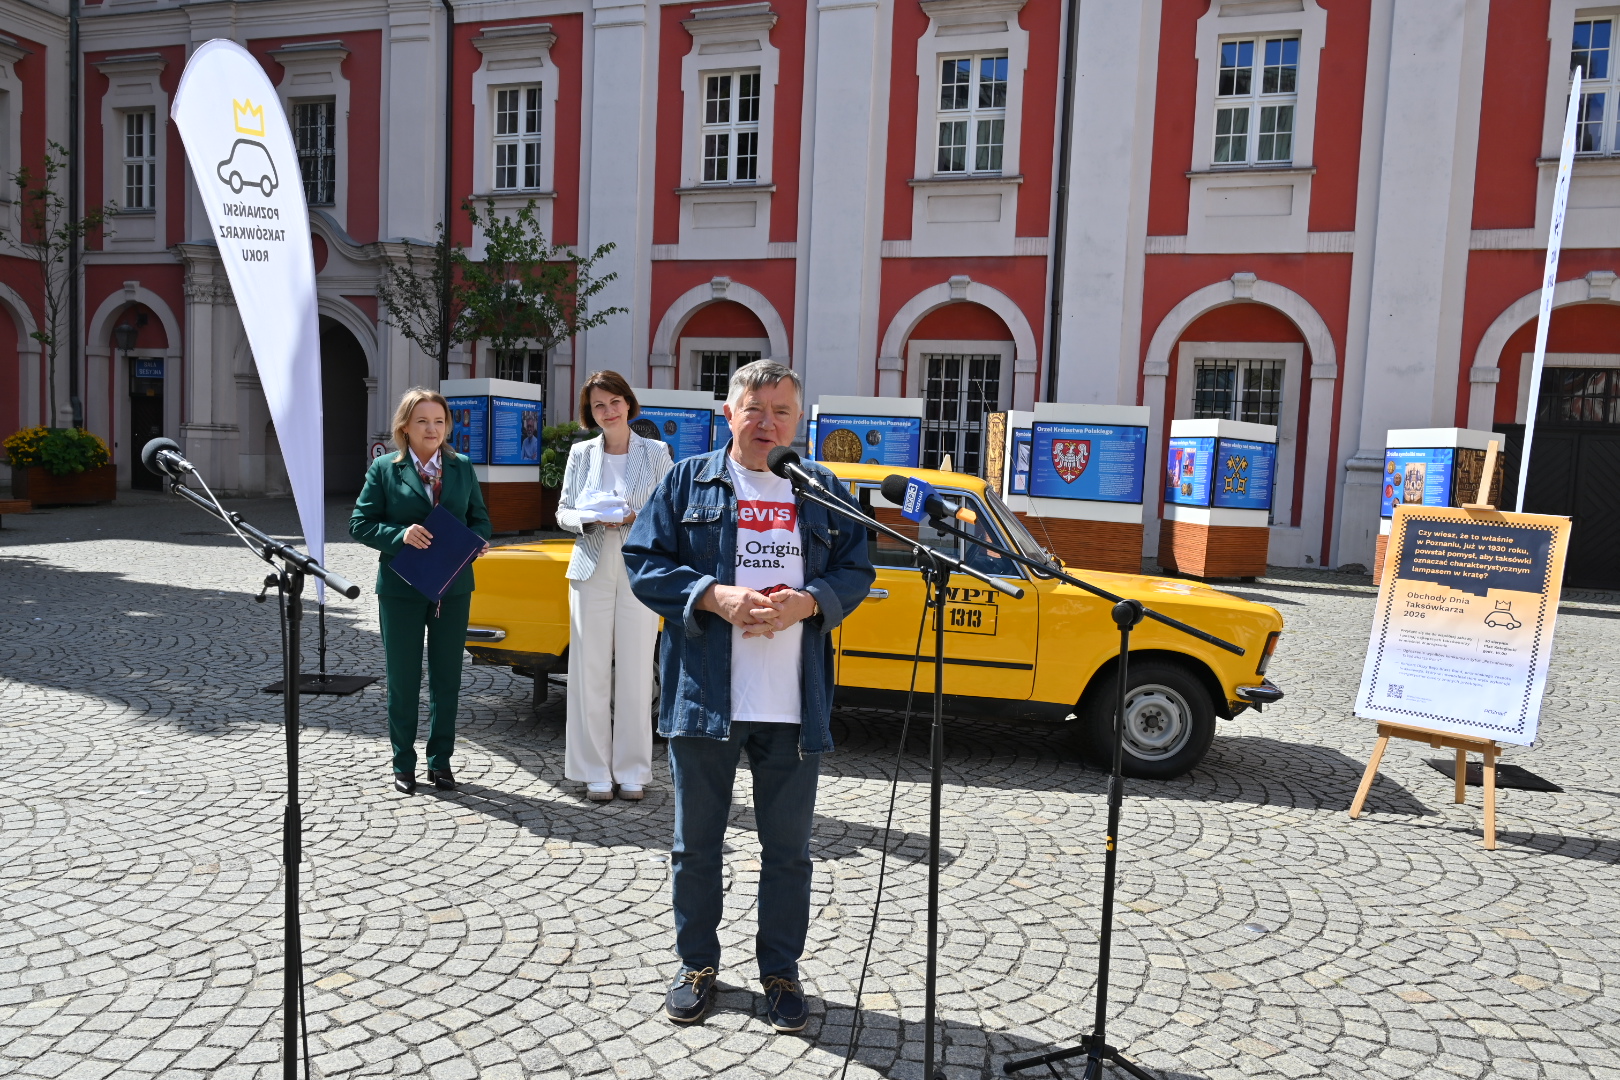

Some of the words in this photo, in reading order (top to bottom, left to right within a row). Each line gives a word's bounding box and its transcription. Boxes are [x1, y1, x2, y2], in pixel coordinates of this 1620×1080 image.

[377, 448, 381, 456] 5
[738, 507, 791, 521] evi's
[1426, 540, 1462, 548] Poznaniu,
[1482, 535, 1514, 543] właśnie
[746, 541, 802, 557] Origin
[735, 555, 784, 568] Jeans.
[1415, 548, 1445, 556] powstał
[1447, 551, 1478, 560] pomysł,
[1480, 554, 1493, 562] aby
[1495, 555, 1532, 564] taksówki
[1412, 566, 1451, 575] lampasem
[1450, 561, 1530, 574] charakterystycznym
[1407, 592, 1447, 603] Obchody
[1449, 596, 1470, 605] Dnia
[1403, 610, 1426, 618] 2026
[1405, 601, 1464, 614] Taksówkarza
[950, 608, 982, 628] 1313
